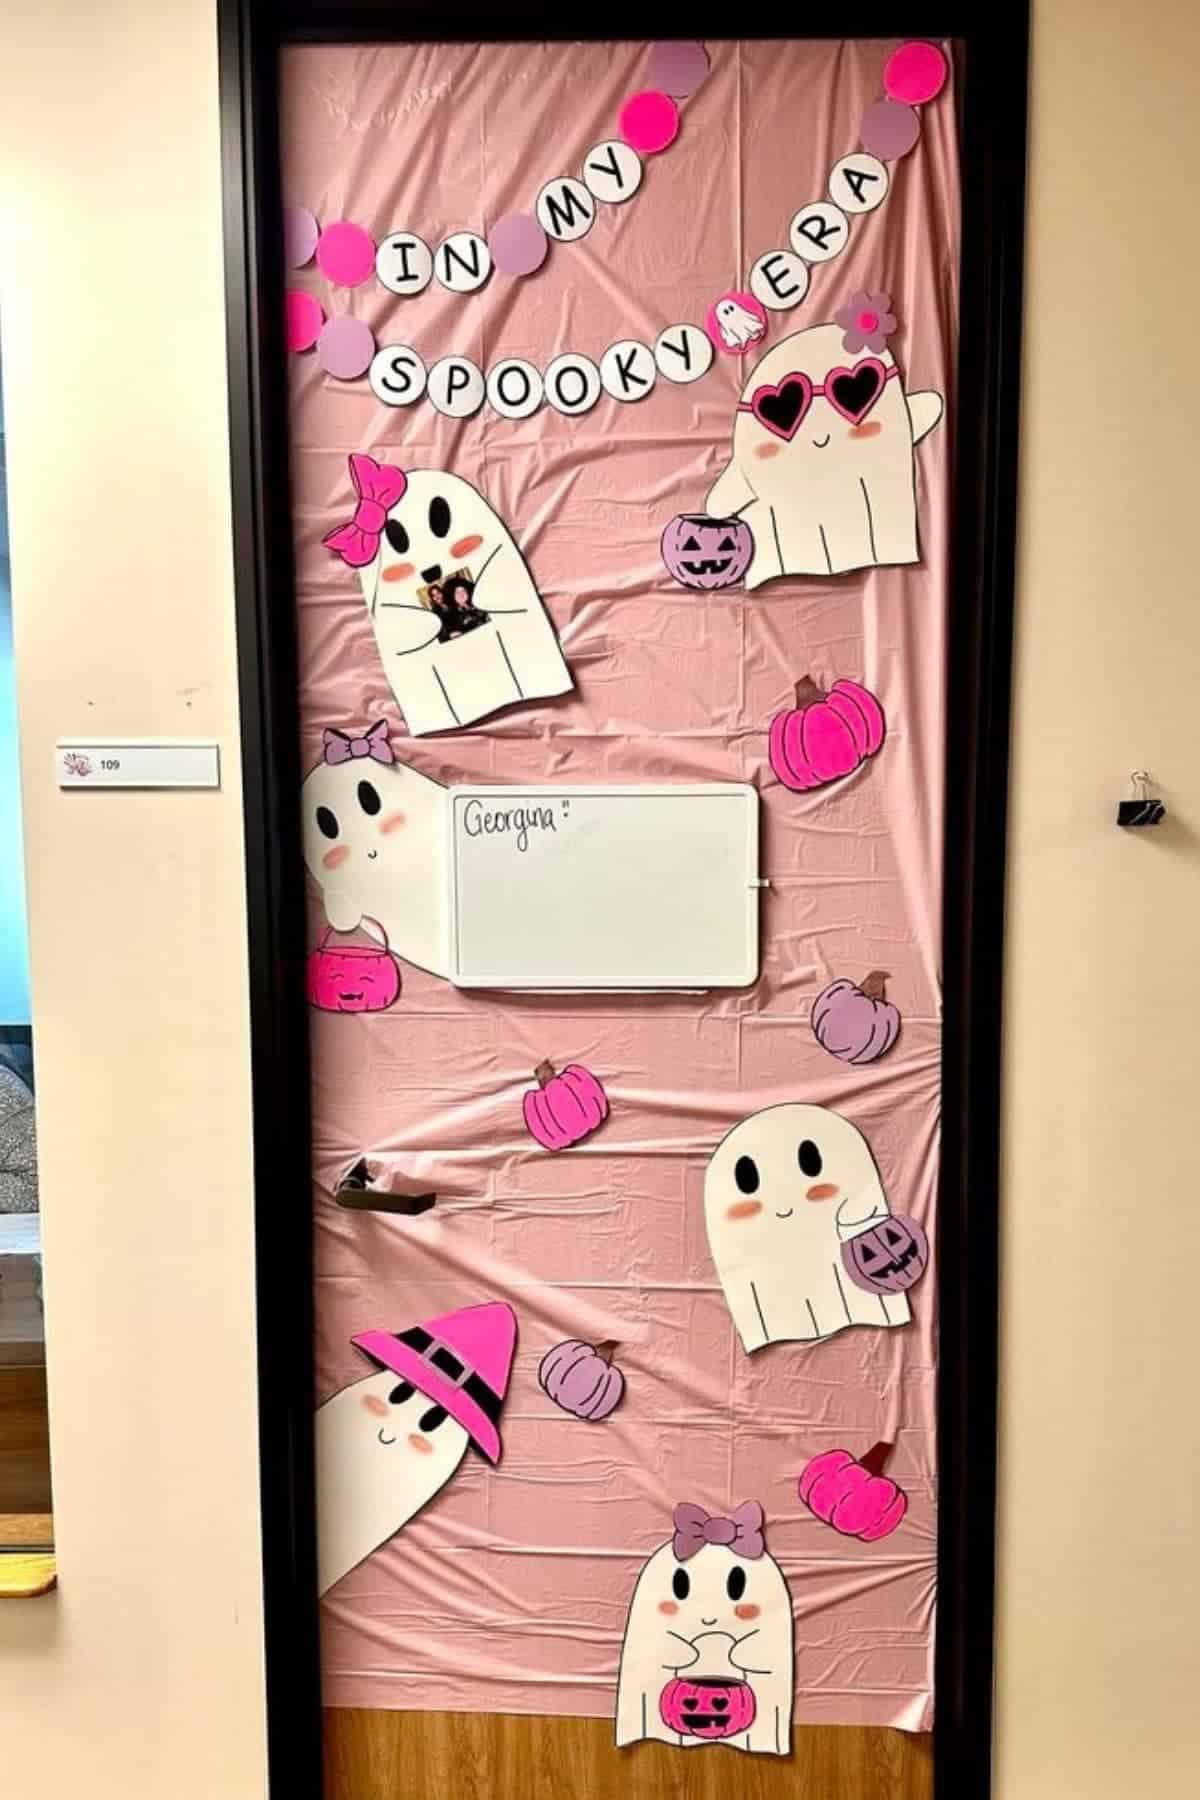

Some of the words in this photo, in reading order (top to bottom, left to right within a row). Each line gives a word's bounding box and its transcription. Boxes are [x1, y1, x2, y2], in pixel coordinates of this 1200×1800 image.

[392, 239, 480, 282] IN
[545, 146, 624, 235] MY
[381, 330, 692, 407] SPOOKY
[760, 168, 879, 299] ERA
[100, 759, 121, 771] 109
